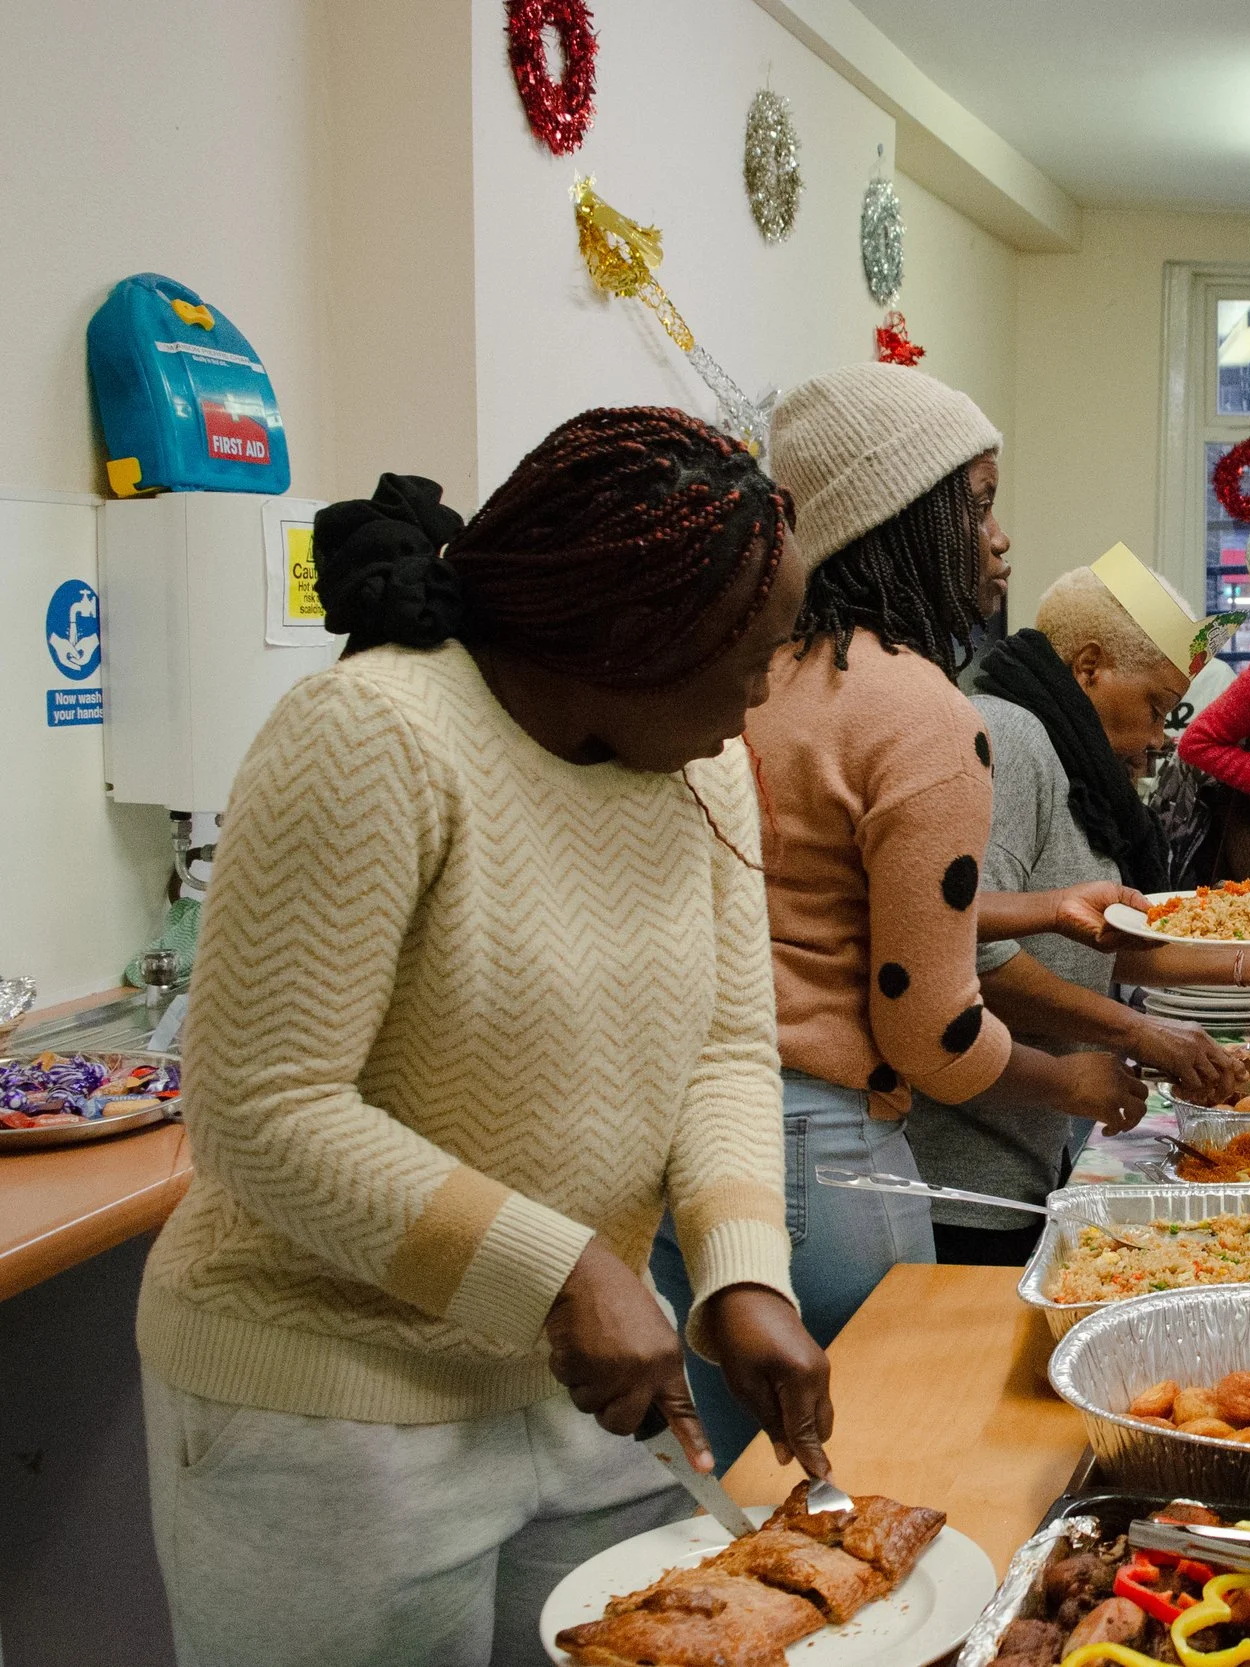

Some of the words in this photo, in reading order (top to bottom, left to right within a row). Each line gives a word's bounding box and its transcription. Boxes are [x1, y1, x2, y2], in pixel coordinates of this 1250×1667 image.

[212, 435, 243, 456] FIRST
[245, 440, 265, 458] AID
[298, 581, 310, 592] Hot
[303, 592, 316, 603] risk
[55, 692, 77, 706] Now
[77, 691, 102, 704] wash
[53, 709, 76, 724] your
